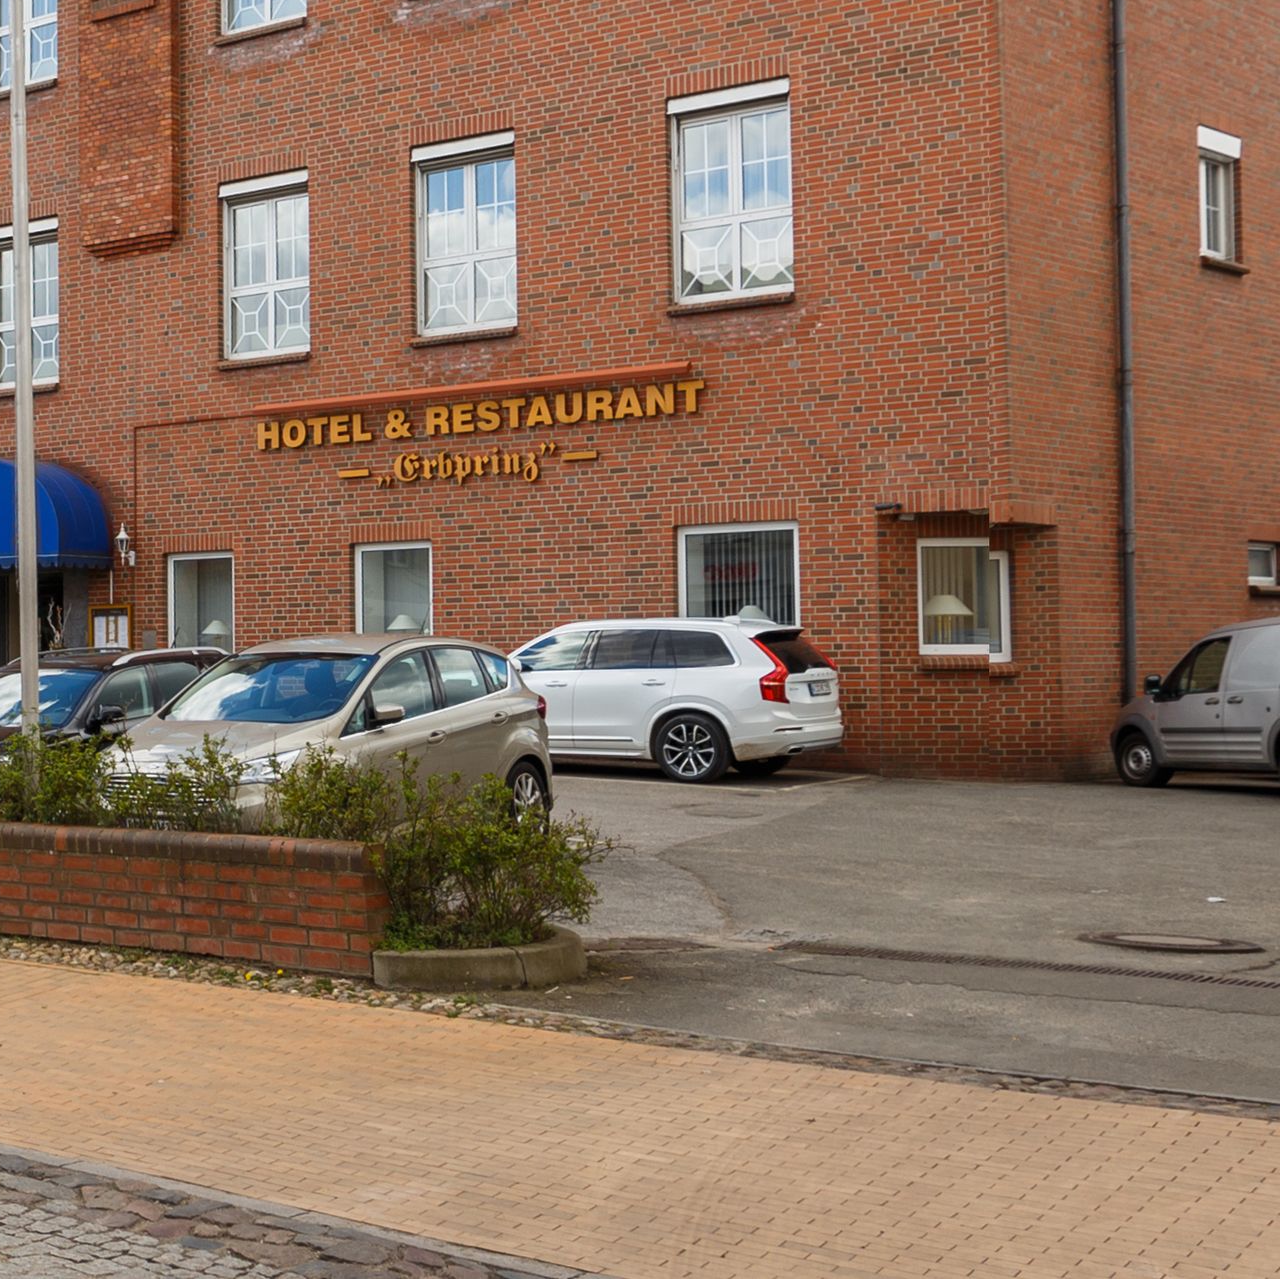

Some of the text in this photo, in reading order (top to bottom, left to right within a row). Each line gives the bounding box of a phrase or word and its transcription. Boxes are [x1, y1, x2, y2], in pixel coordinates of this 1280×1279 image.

[257, 380, 705, 450] HOTEL & RESTAURANT
